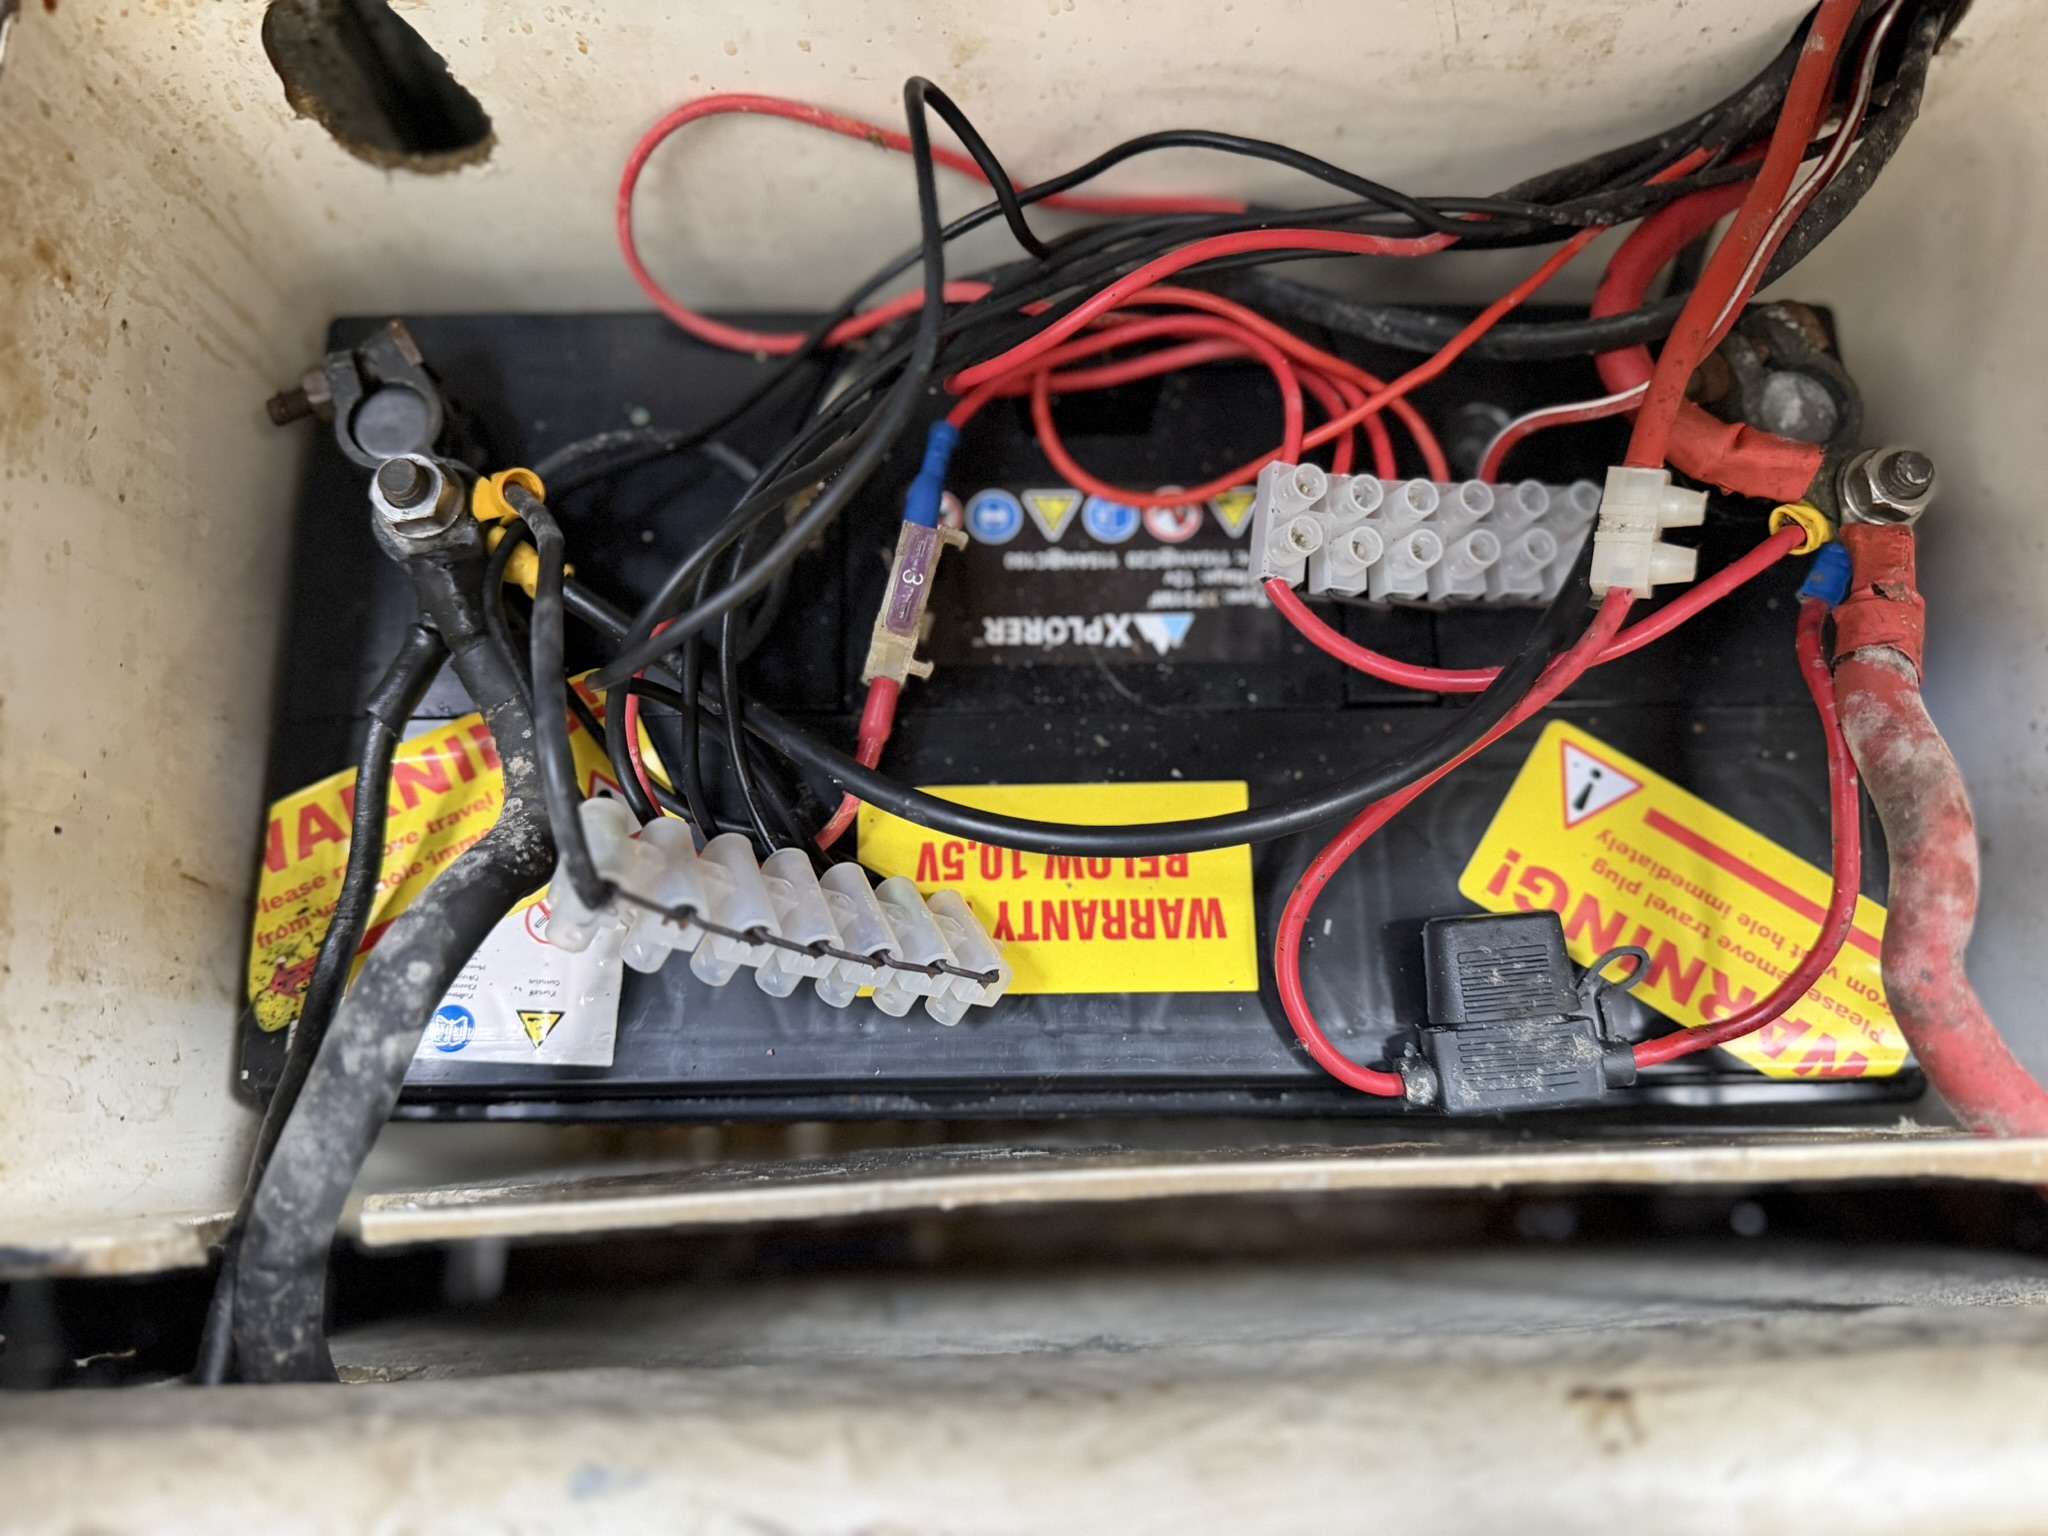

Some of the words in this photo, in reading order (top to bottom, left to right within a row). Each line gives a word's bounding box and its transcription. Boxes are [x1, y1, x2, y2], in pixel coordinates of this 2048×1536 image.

[902, 569, 924, 586] 3
[257, 873, 335, 914] lease
[426, 792, 494, 835] travel
[916, 841, 1027, 882] 10.5V
[1590, 857, 1643, 895] plug
[1596, 828, 1733, 918] immediately
[993, 898, 1227, 941] WARRANTY
[1644, 893, 1712, 941] travel
[1738, 913, 1786, 951] hole
[1486, 849, 1868, 1077] WARNING!
[1717, 934, 1792, 983] emove
[1806, 987, 1886, 1044] Please
